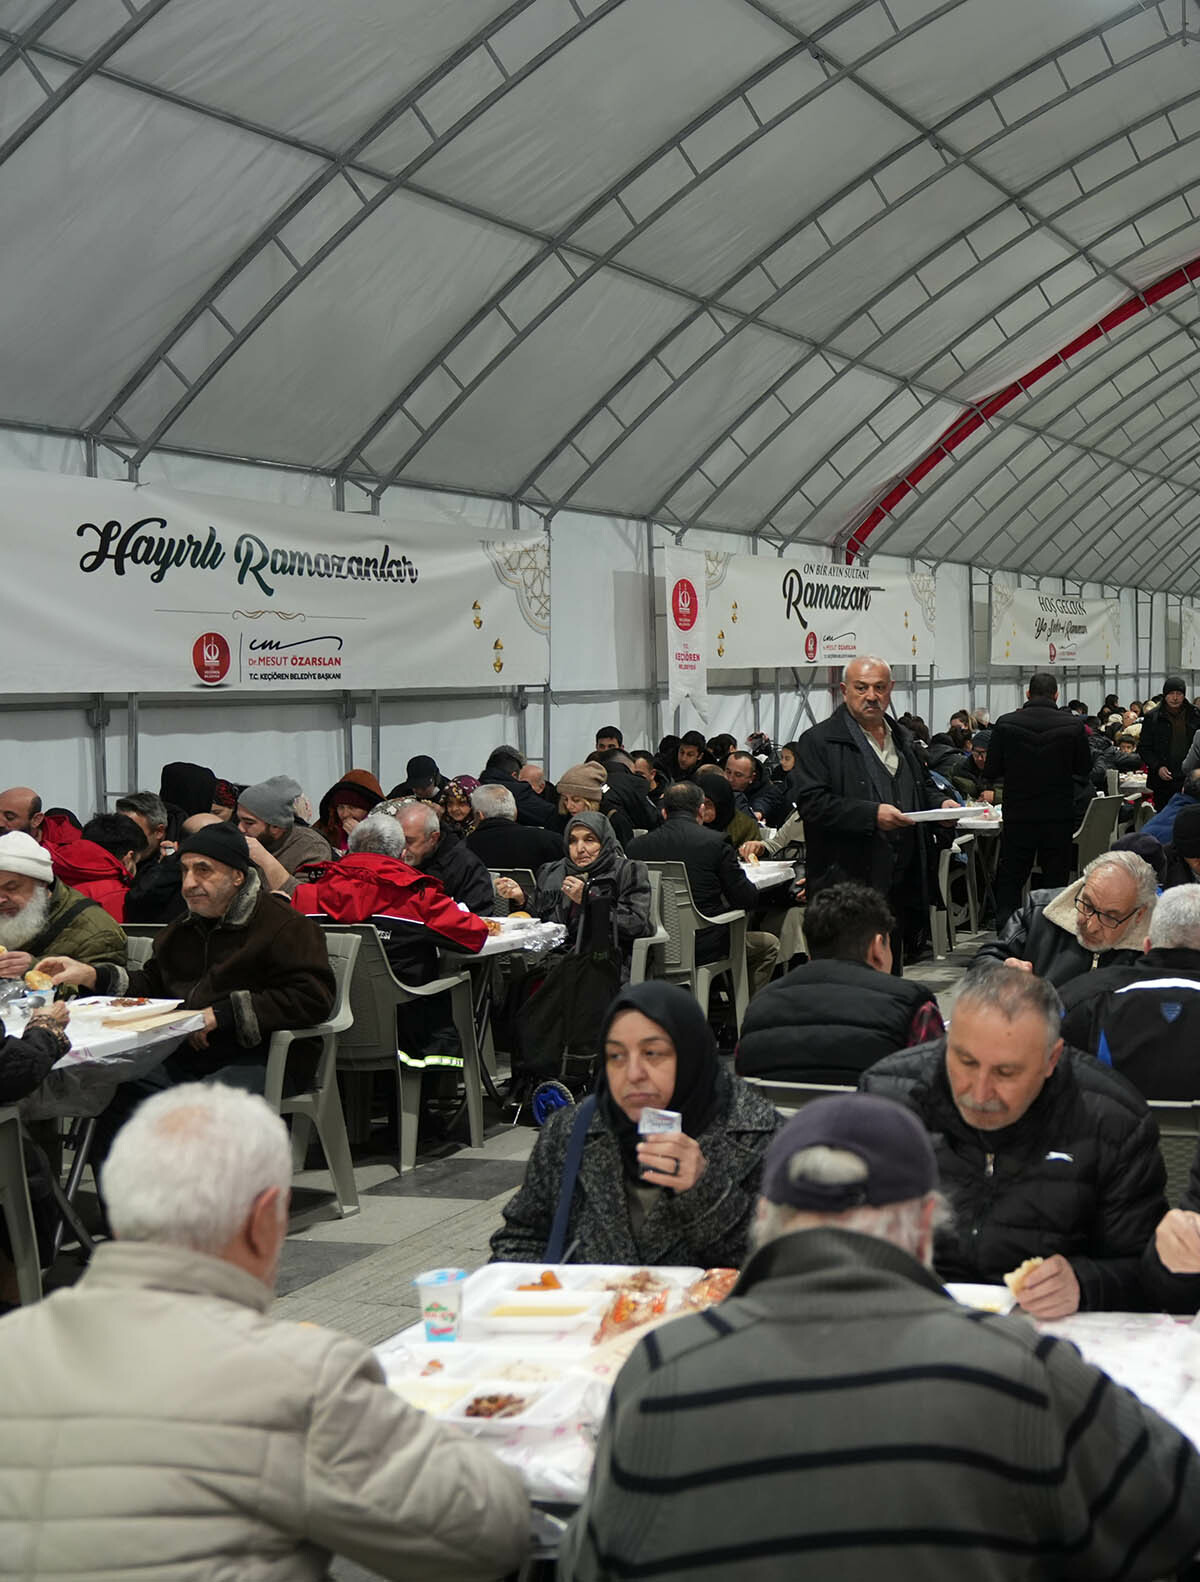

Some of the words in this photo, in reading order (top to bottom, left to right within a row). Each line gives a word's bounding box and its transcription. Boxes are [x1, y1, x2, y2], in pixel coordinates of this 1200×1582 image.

[76, 517, 226, 583] Hayırlı
[233, 533, 419, 597] Ramazanlar
[803, 563, 816, 575] ON
[816, 564, 828, 577] BİR
[828, 566, 843, 578] AYIN
[782, 568, 886, 630] Ramazan
[290, 654, 342, 667] ÖZARSLAN
[260, 671, 289, 682] KEÇİÖREN
[289, 671, 317, 681] BELEDİYE
[317, 672, 342, 682] BAŞKANI
